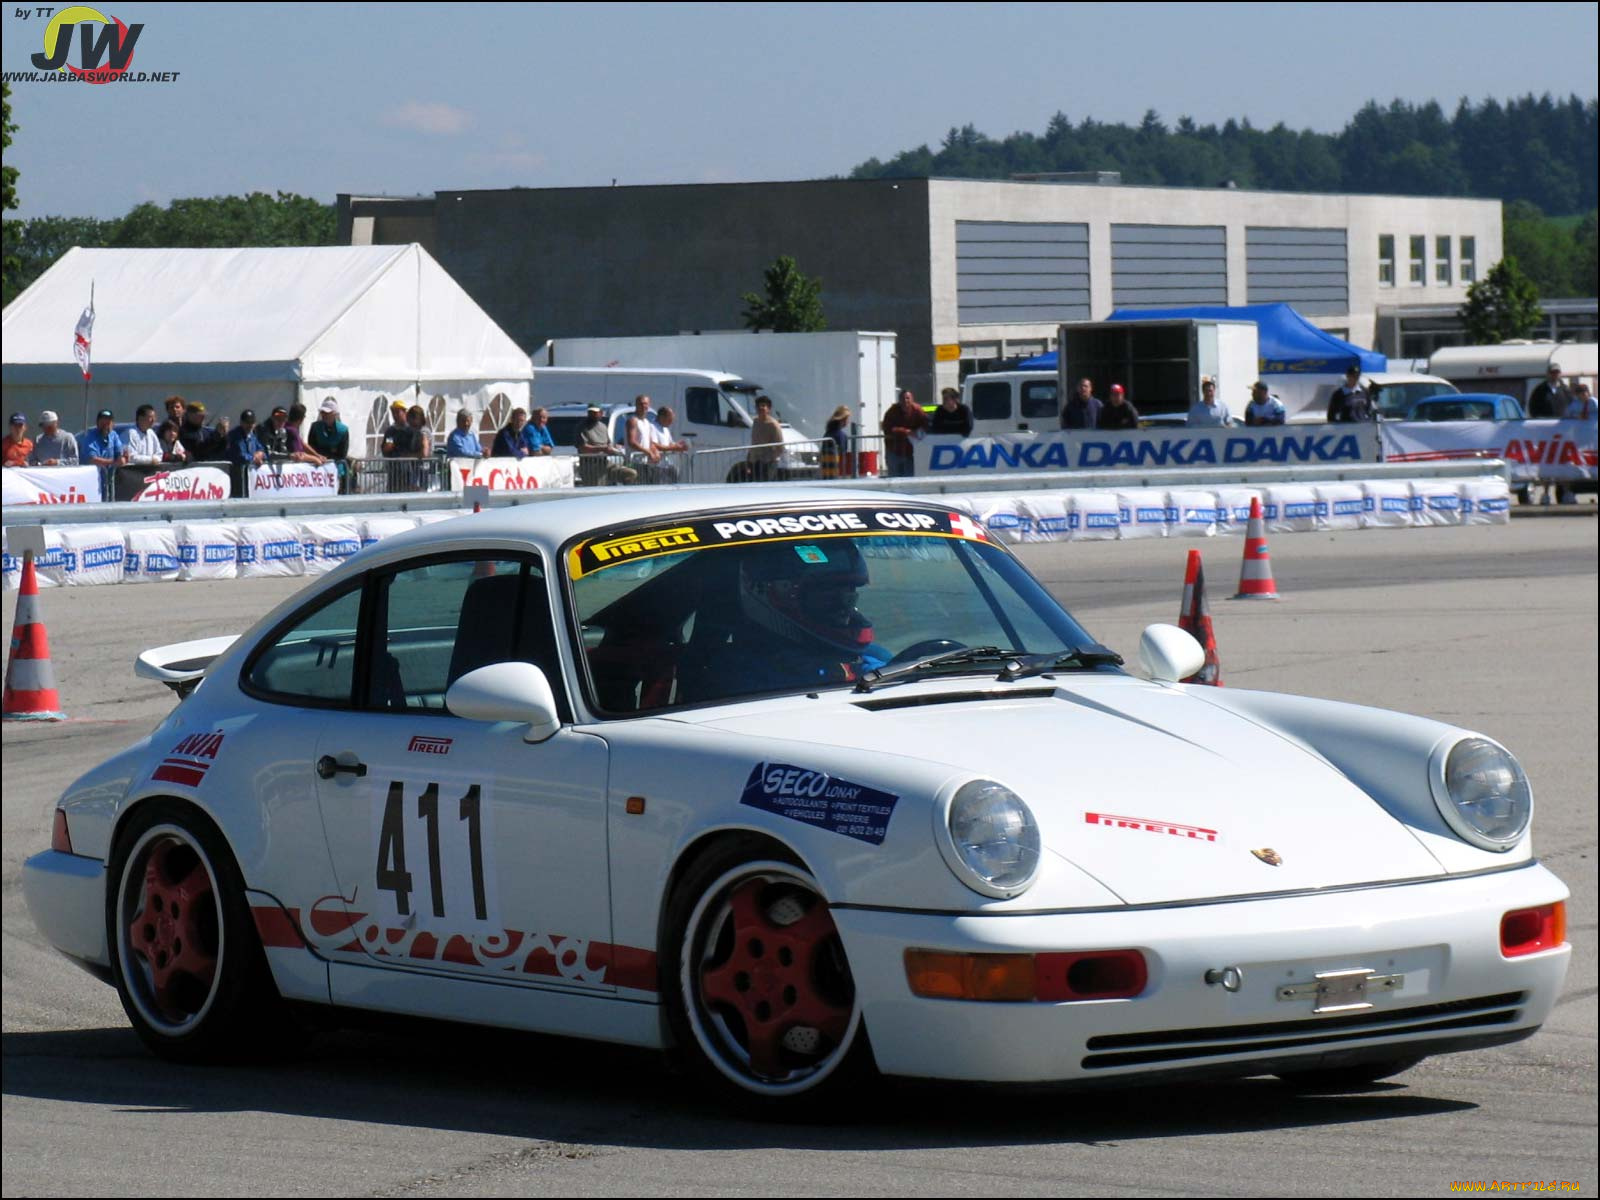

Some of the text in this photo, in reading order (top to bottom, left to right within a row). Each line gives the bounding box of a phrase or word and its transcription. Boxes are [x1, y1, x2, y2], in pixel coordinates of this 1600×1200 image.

[928, 434, 1361, 471] DANKA DANKA DANKA
[165, 477, 191, 489] RADIO
[254, 472, 312, 491] AUTOMOBIL
[590, 512, 936, 562] PIRELLI PORSCHE CUP
[408, 736, 454, 755] PIRELLI
[764, 768, 861, 799] SECO LONAY
[1085, 812, 1218, 842] PIRELLI
[377, 781, 487, 920] 411
[300, 884, 607, 983] Carrera
